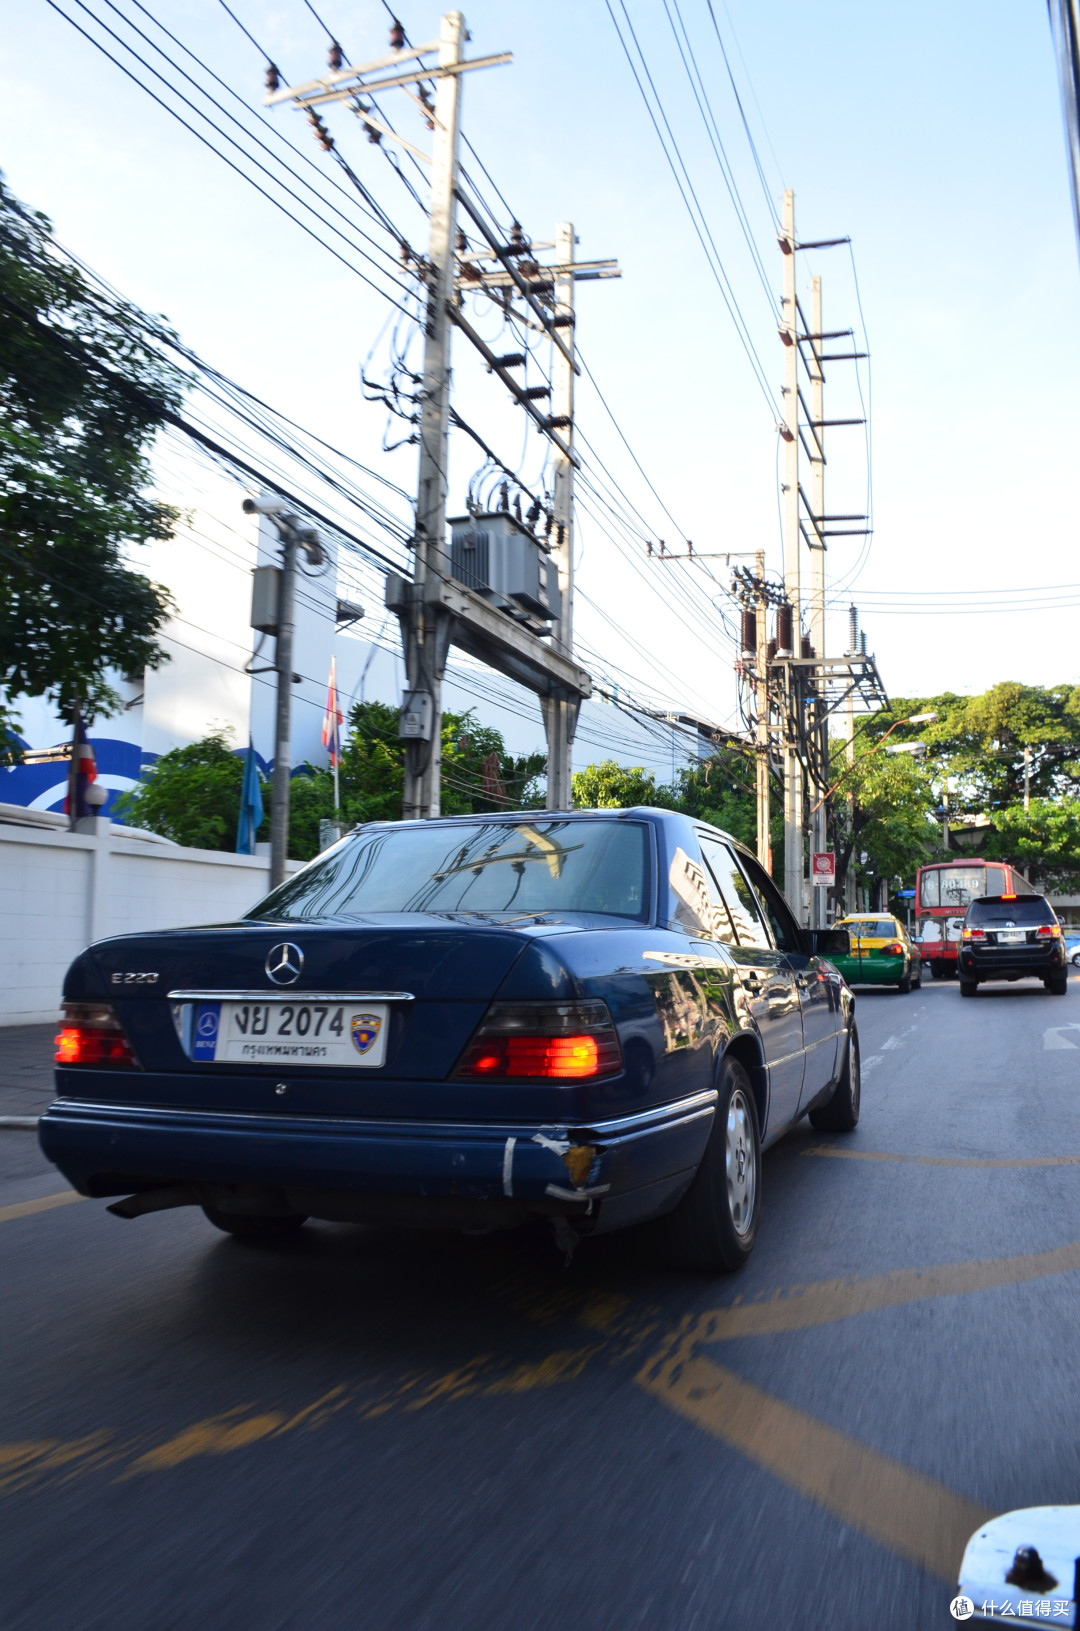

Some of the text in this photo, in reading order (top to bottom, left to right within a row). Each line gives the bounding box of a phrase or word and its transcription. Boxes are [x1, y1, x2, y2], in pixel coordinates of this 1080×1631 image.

[279, 1006, 345, 1037] 2074
[195, 1040, 216, 1048] BENZ
[242, 1044, 327, 1059] กรุงเทพมหานคร
